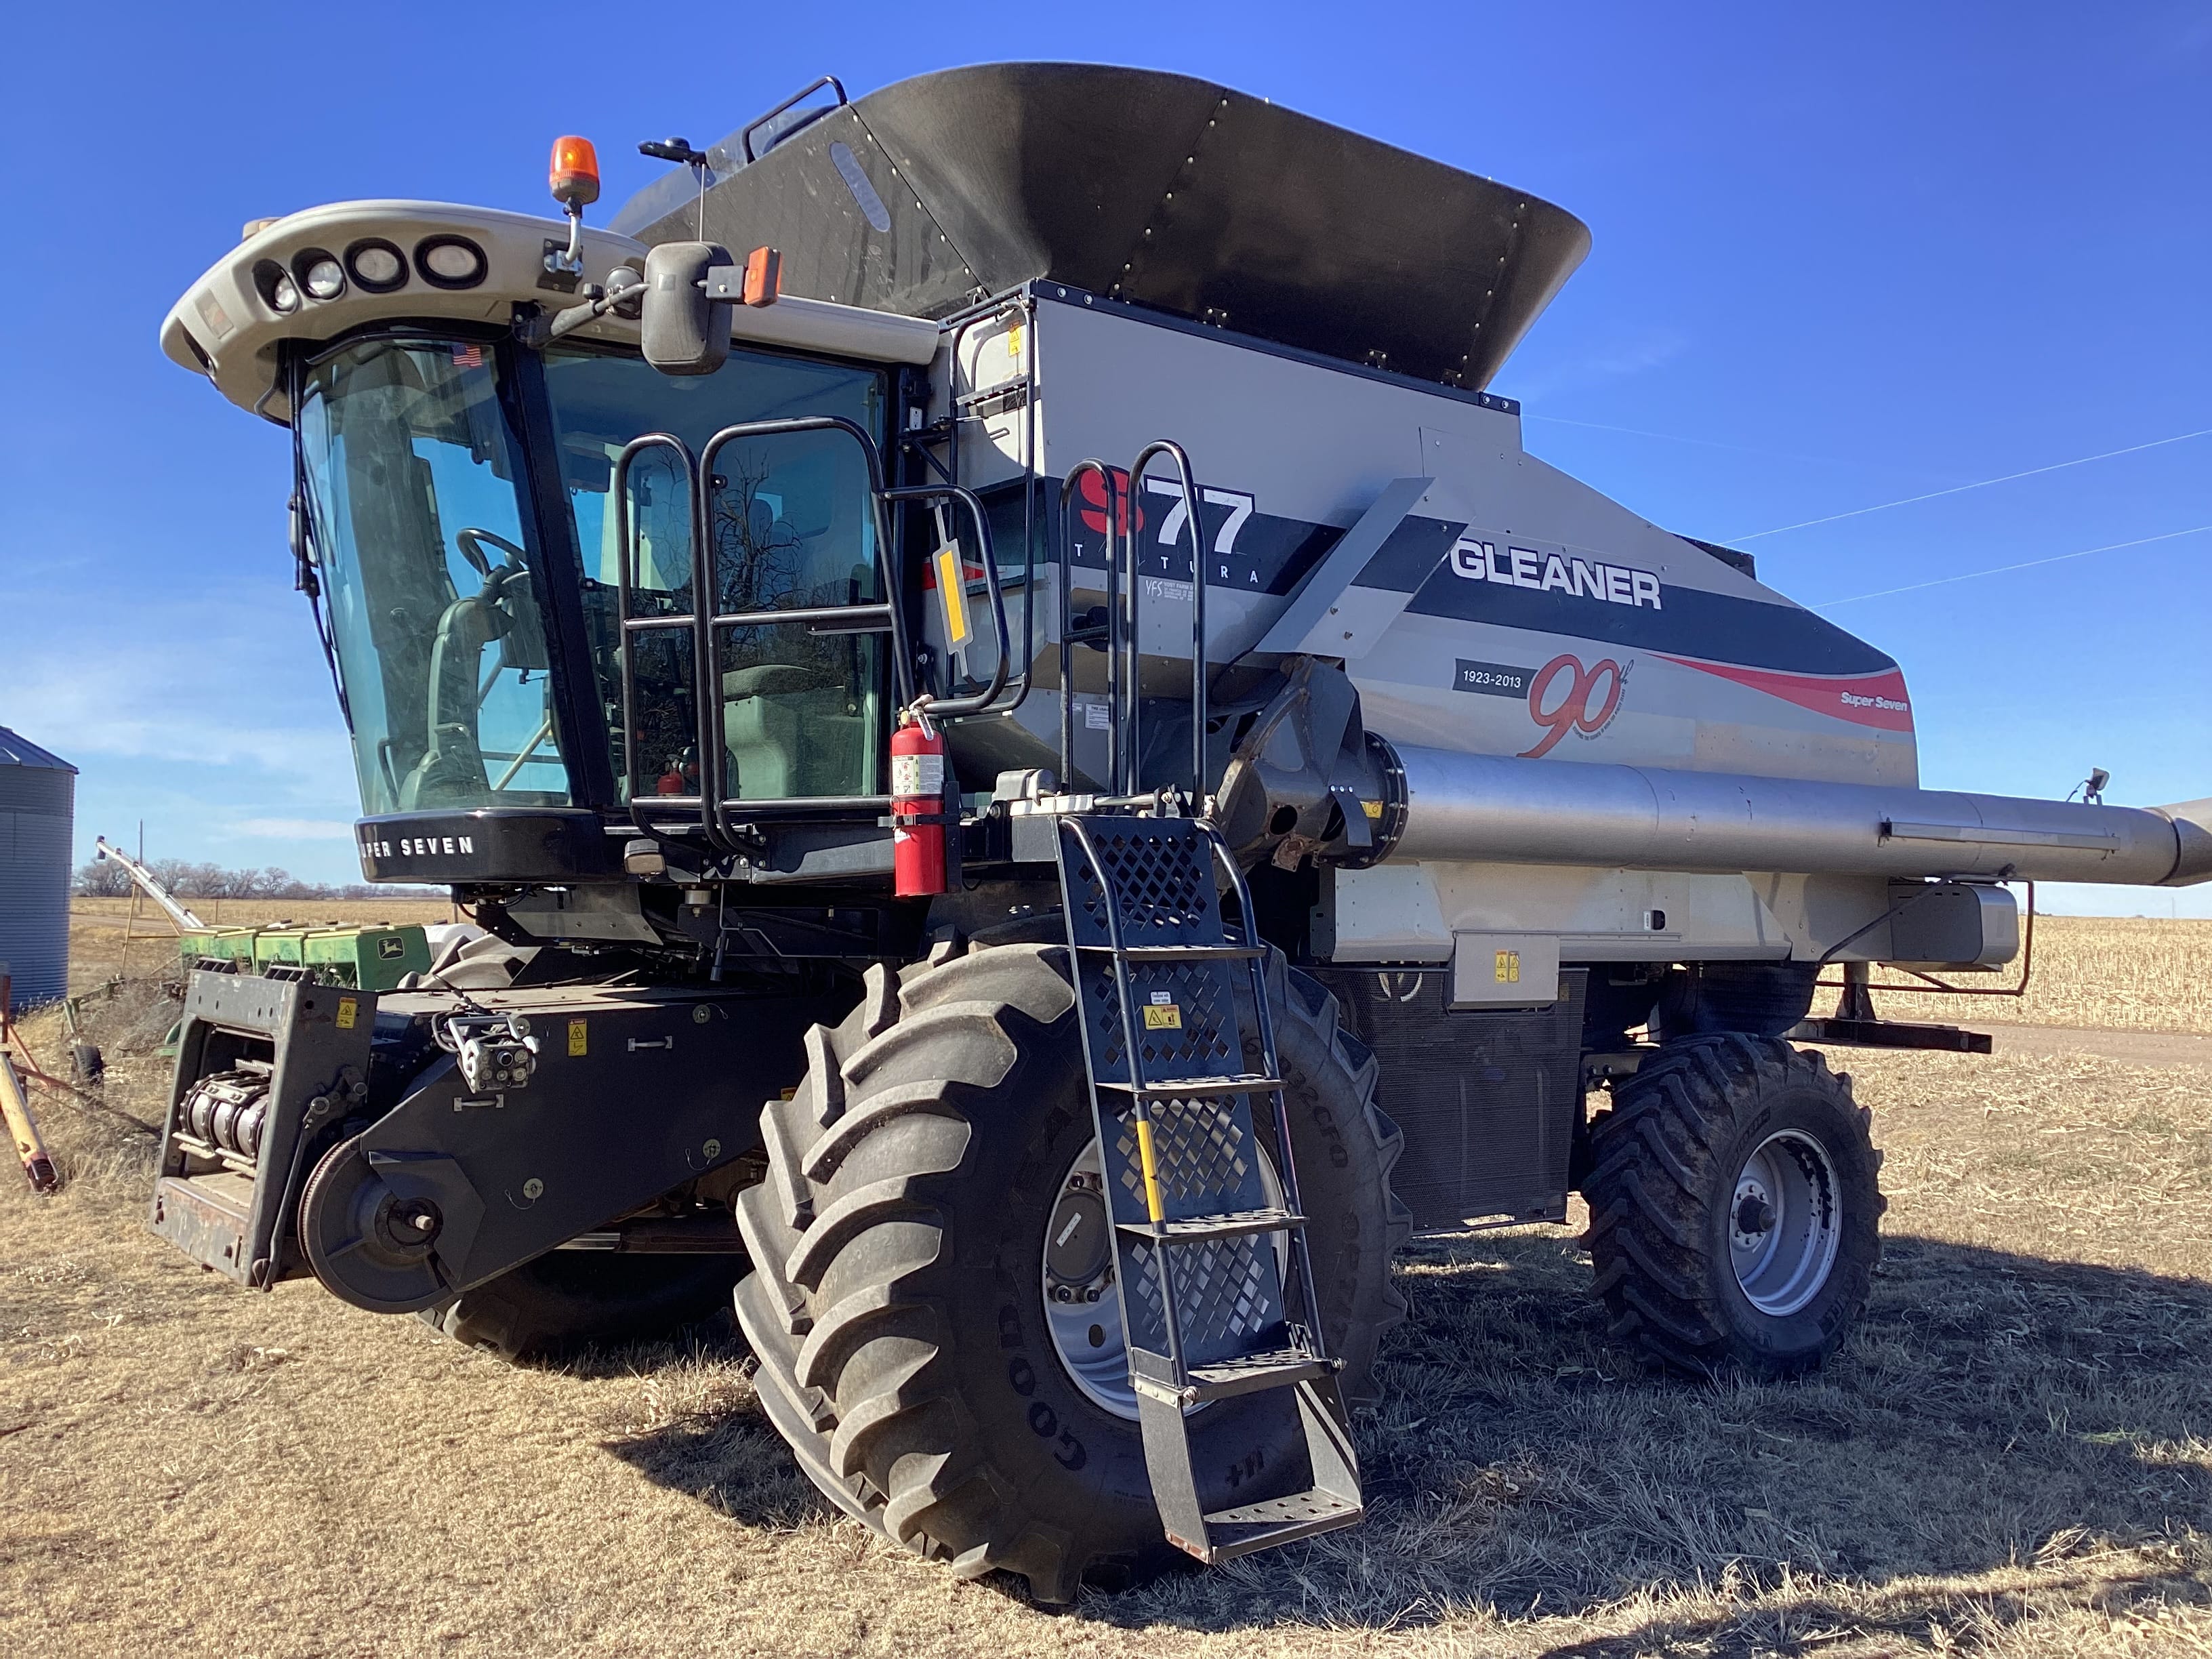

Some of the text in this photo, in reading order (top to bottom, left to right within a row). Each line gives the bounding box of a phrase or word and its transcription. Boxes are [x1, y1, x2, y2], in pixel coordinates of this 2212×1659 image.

[1450, 539, 1662, 610] GLEANER
[1145, 579, 1163, 597] YFS
[1464, 670, 1521, 688] 1923-2013
[1841, 691, 1908, 712] Super Seven
[360, 836, 474, 858] UPER SEVEN
